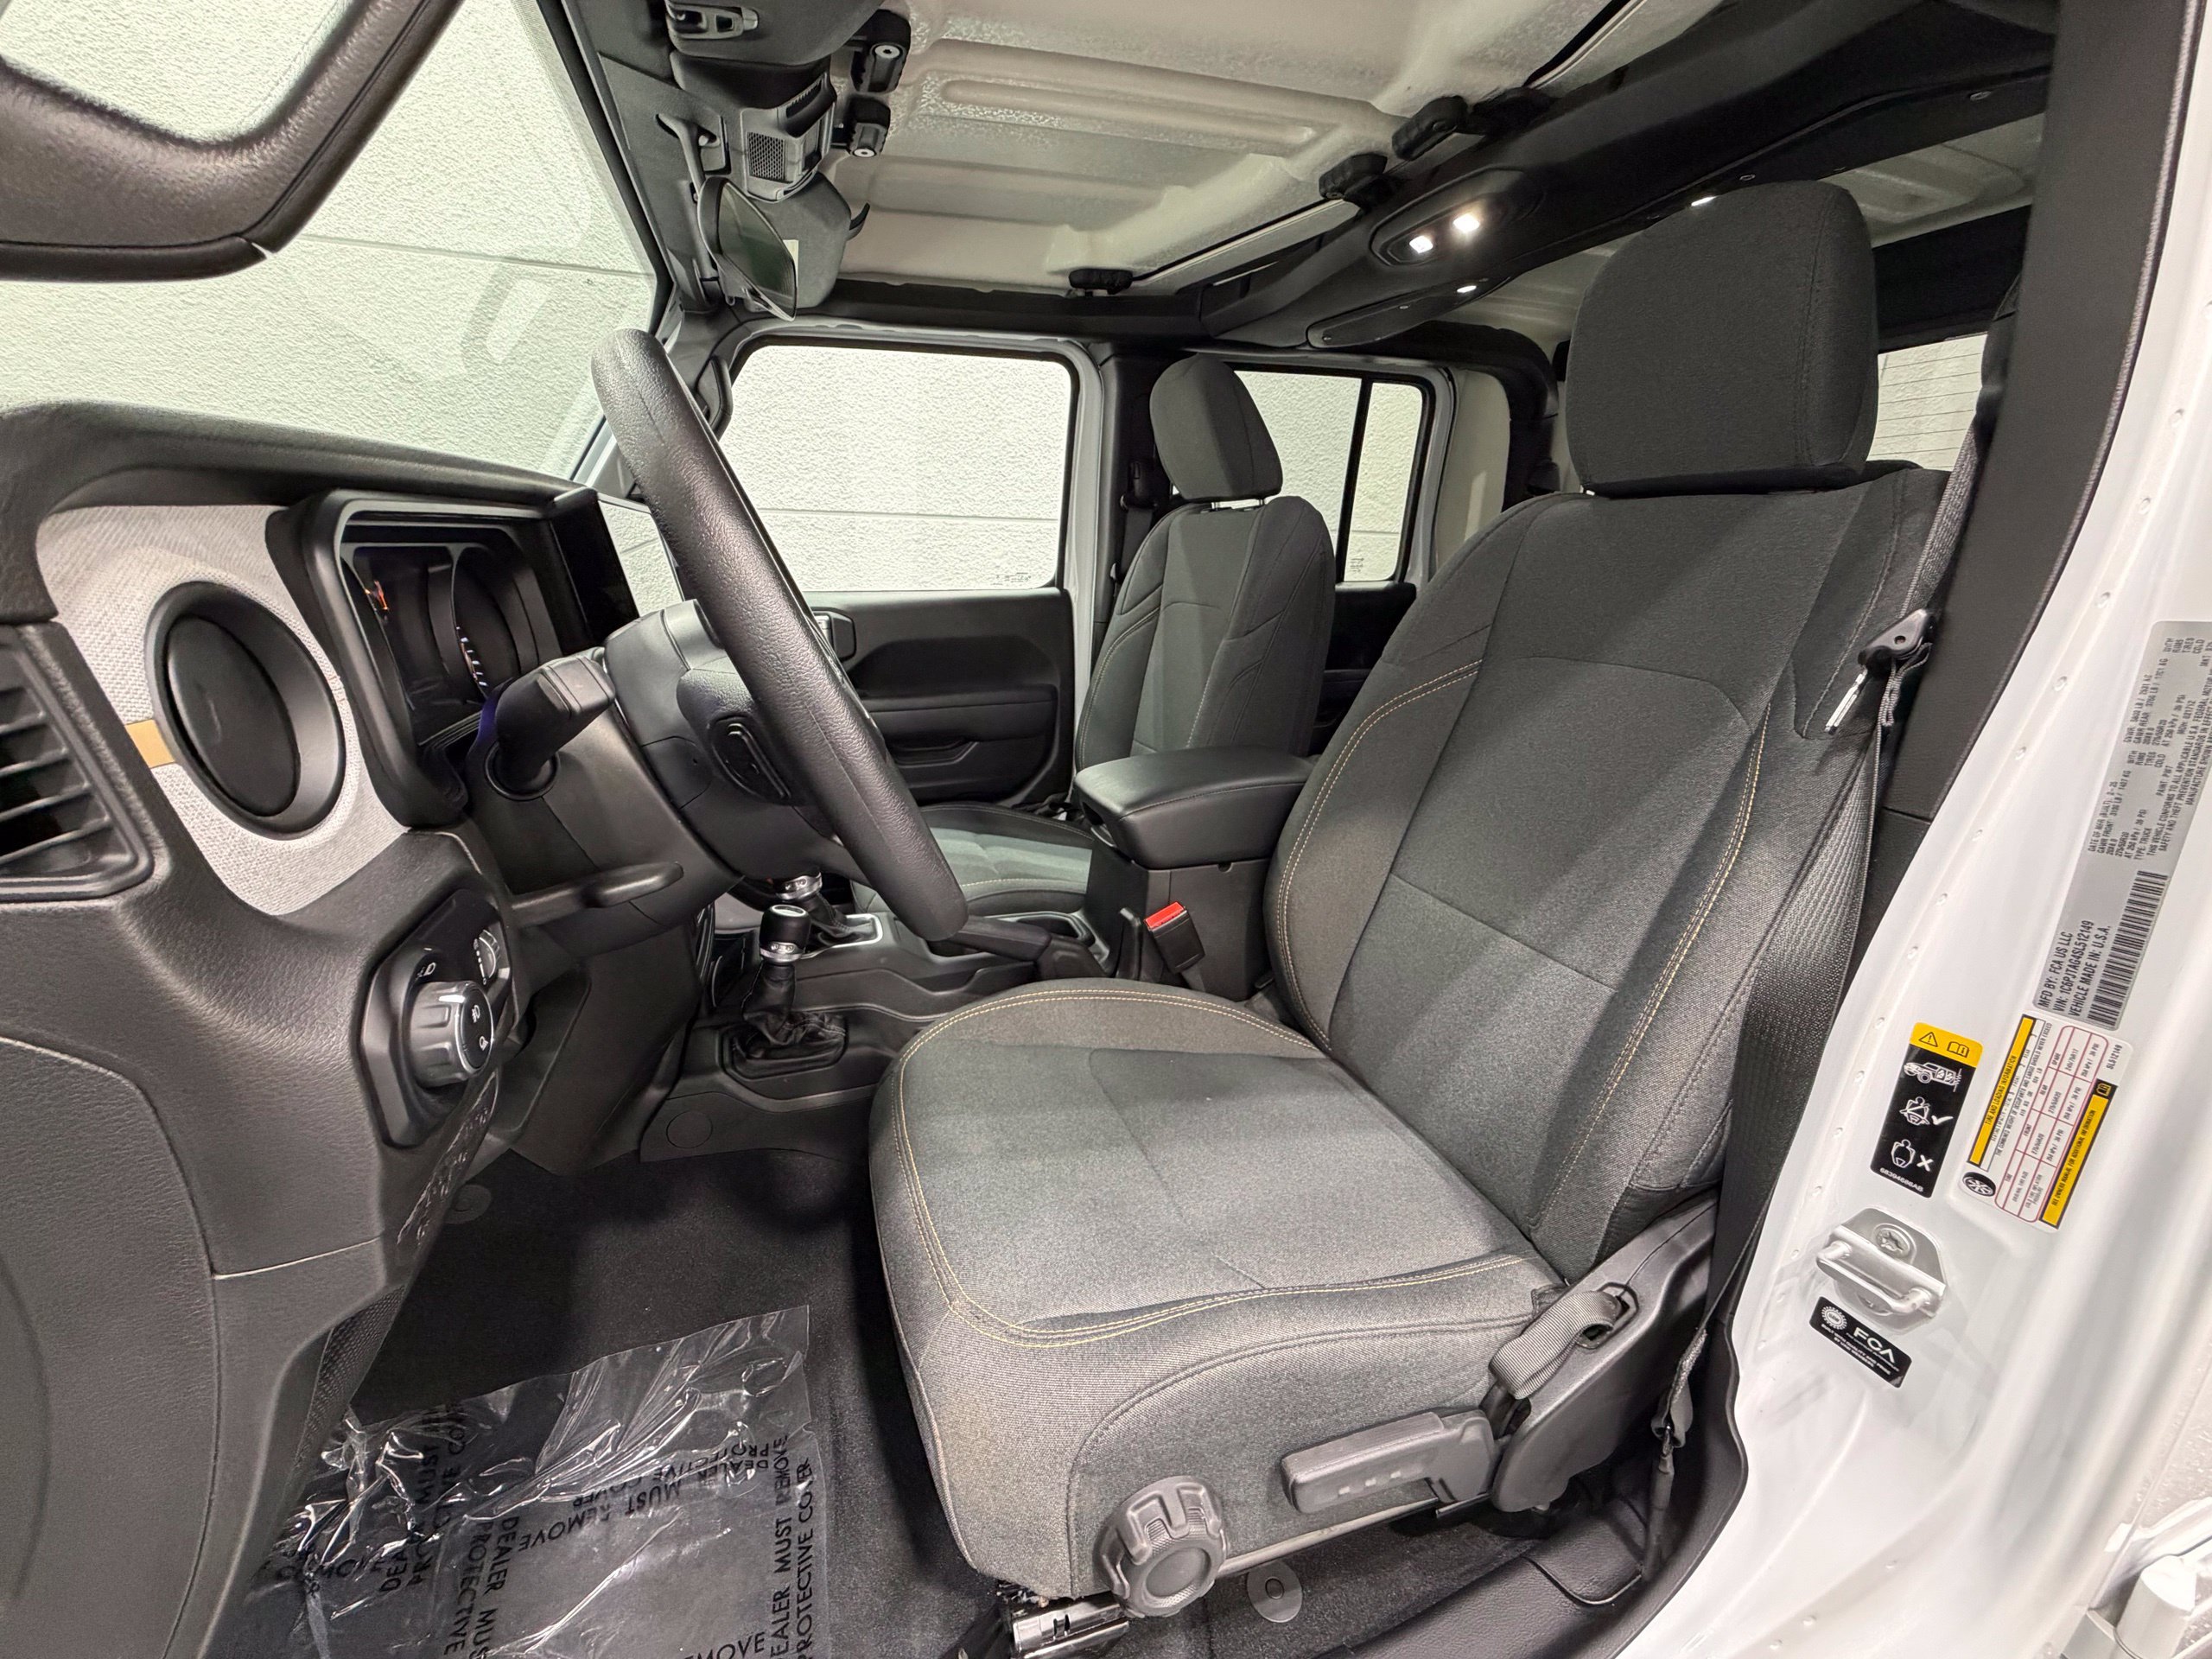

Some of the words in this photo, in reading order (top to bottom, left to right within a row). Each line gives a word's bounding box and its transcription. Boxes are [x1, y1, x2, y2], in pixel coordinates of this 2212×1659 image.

[2176, 741, 2193, 773] APPLICABLE
[2188, 734, 2205, 766] STANDARDS
[2171, 774, 2183, 785] ALL
[2176, 768, 2194, 801] PREVENTION
[2184, 765, 2206, 805] MANUFACTURE
[2158, 793, 2175, 822] CONFORMS
[2170, 802, 2182, 818] THEFT
[2152, 823, 2165, 843] VEHICLE
[2165, 819, 2177, 831] AND
[2088, 839, 2099, 852] DATE
[2097, 838, 2108, 854] GAWR
[2146, 844, 2158, 856] THIS
[2158, 832, 2171, 851] SAFETY
[2057, 931, 2073, 946] LLC
[2091, 925, 2110, 949] U.S.A.
[2054, 946, 2068, 958] US
[2060, 920, 2094, 995] 1C6PJTAG4SL512149
[2087, 950, 2101, 962] IN:
[2049, 960, 2063, 975] FCA
[2079, 962, 2097, 985] MADE
[2044, 976, 2058, 989] BY:
[2037, 990, 2053, 1007] MFD
[2052, 996, 2069, 1012] VIN:
[2069, 986, 2089, 1016] VEHICLE
[2051, 1052, 2061, 1065] SPARE
[2106, 1044, 2122, 1070] SL512149
[2001, 1055, 2017, 1085] INFORMATION
[1993, 1085, 2005, 1105] LOADING
[1998, 1130, 2010, 1148] COMBINED
[2005, 1115, 2014, 1129] WEIGHT
[2012, 1088, 2026, 1109] OCCUPANTS
[2024, 1066, 2035, 1079] CARGO
[2031, 1051, 2041, 1066] SHOULD
[2037, 1038, 2046, 1051] NEVER
[2042, 1022, 2052, 1038] EXCEED
[1985, 1115, 1994, 1125] TIRE
[1989, 1104, 1998, 1115] AND
[1853, 1327, 1894, 1363] FCA
[625, 1478, 683, 1515] MUST
[518, 1503, 612, 1552] REMOVE
[773, 1516, 792, 1573] MUST
[483, 1516, 520, 1597] DEALER
[443, 1522, 495, 1656] PROTECTIVE
[770, 1584, 791, 1659] EALER
